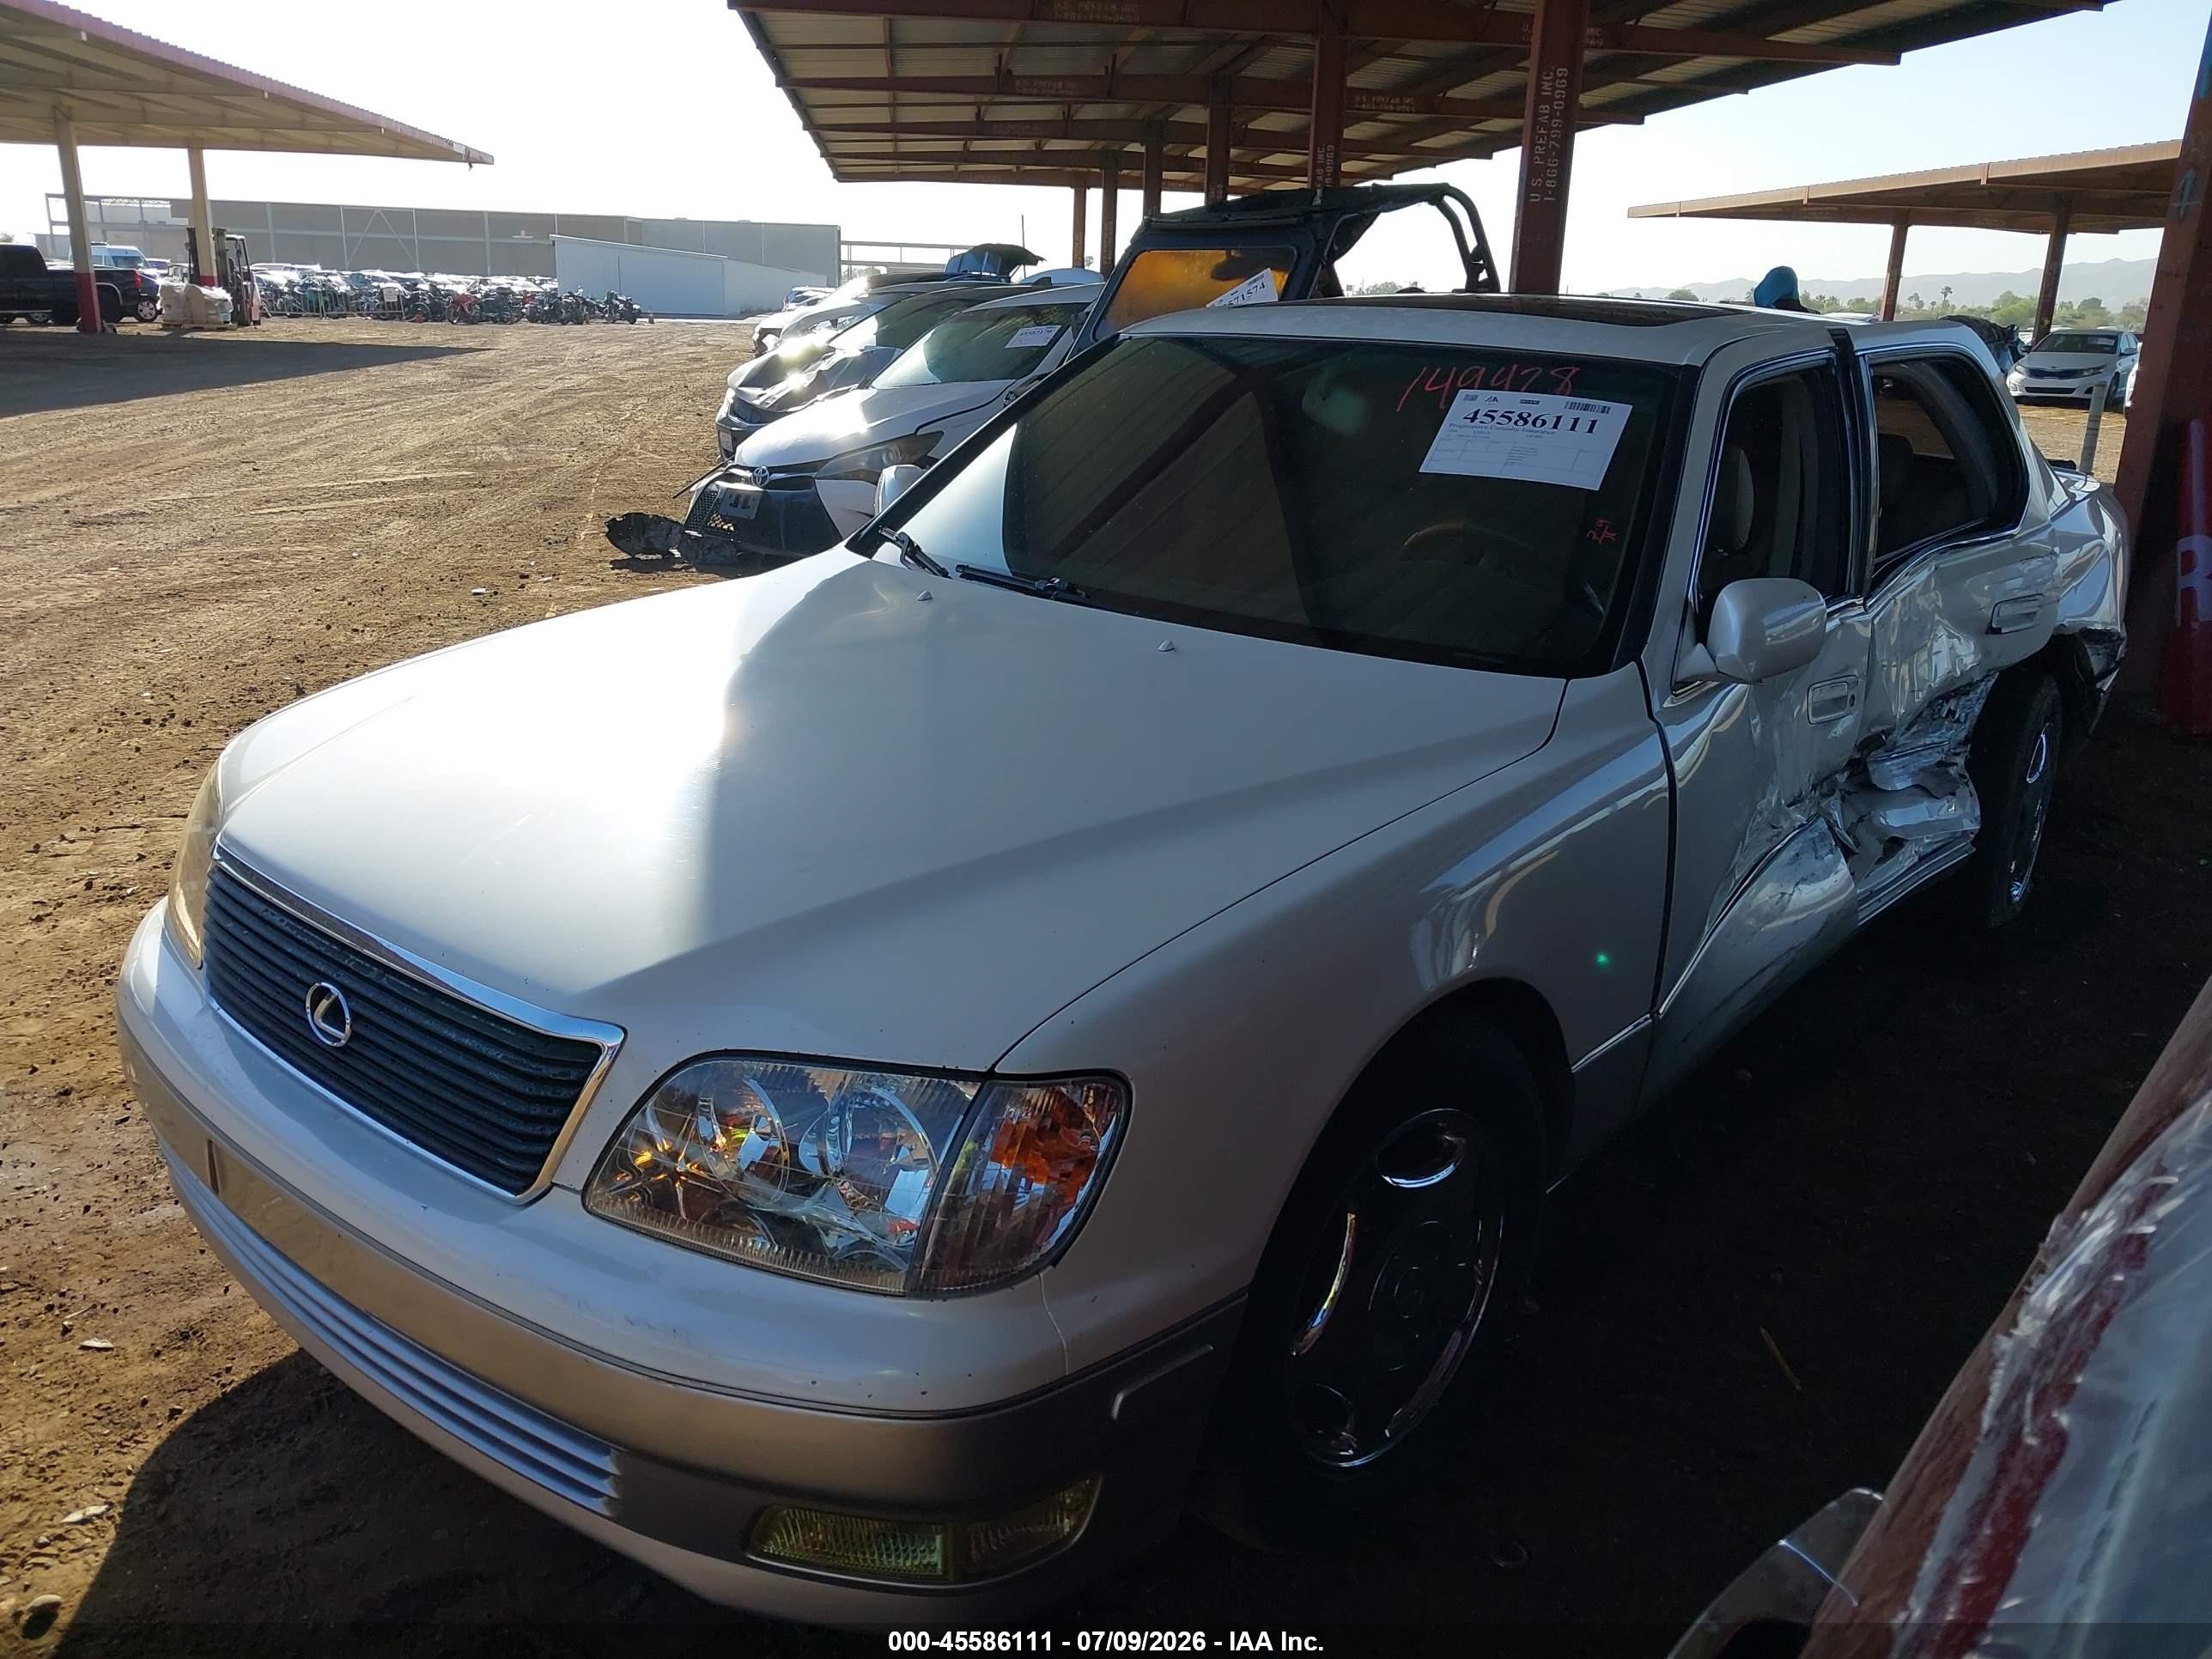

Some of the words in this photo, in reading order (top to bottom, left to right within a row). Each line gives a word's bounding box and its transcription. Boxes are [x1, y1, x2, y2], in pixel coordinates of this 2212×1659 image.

[1534, 104, 1551, 164] PREFAB
[1543, 67, 1568, 201] 1-866-799-0969
[1462, 407, 1599, 435] 45586111
